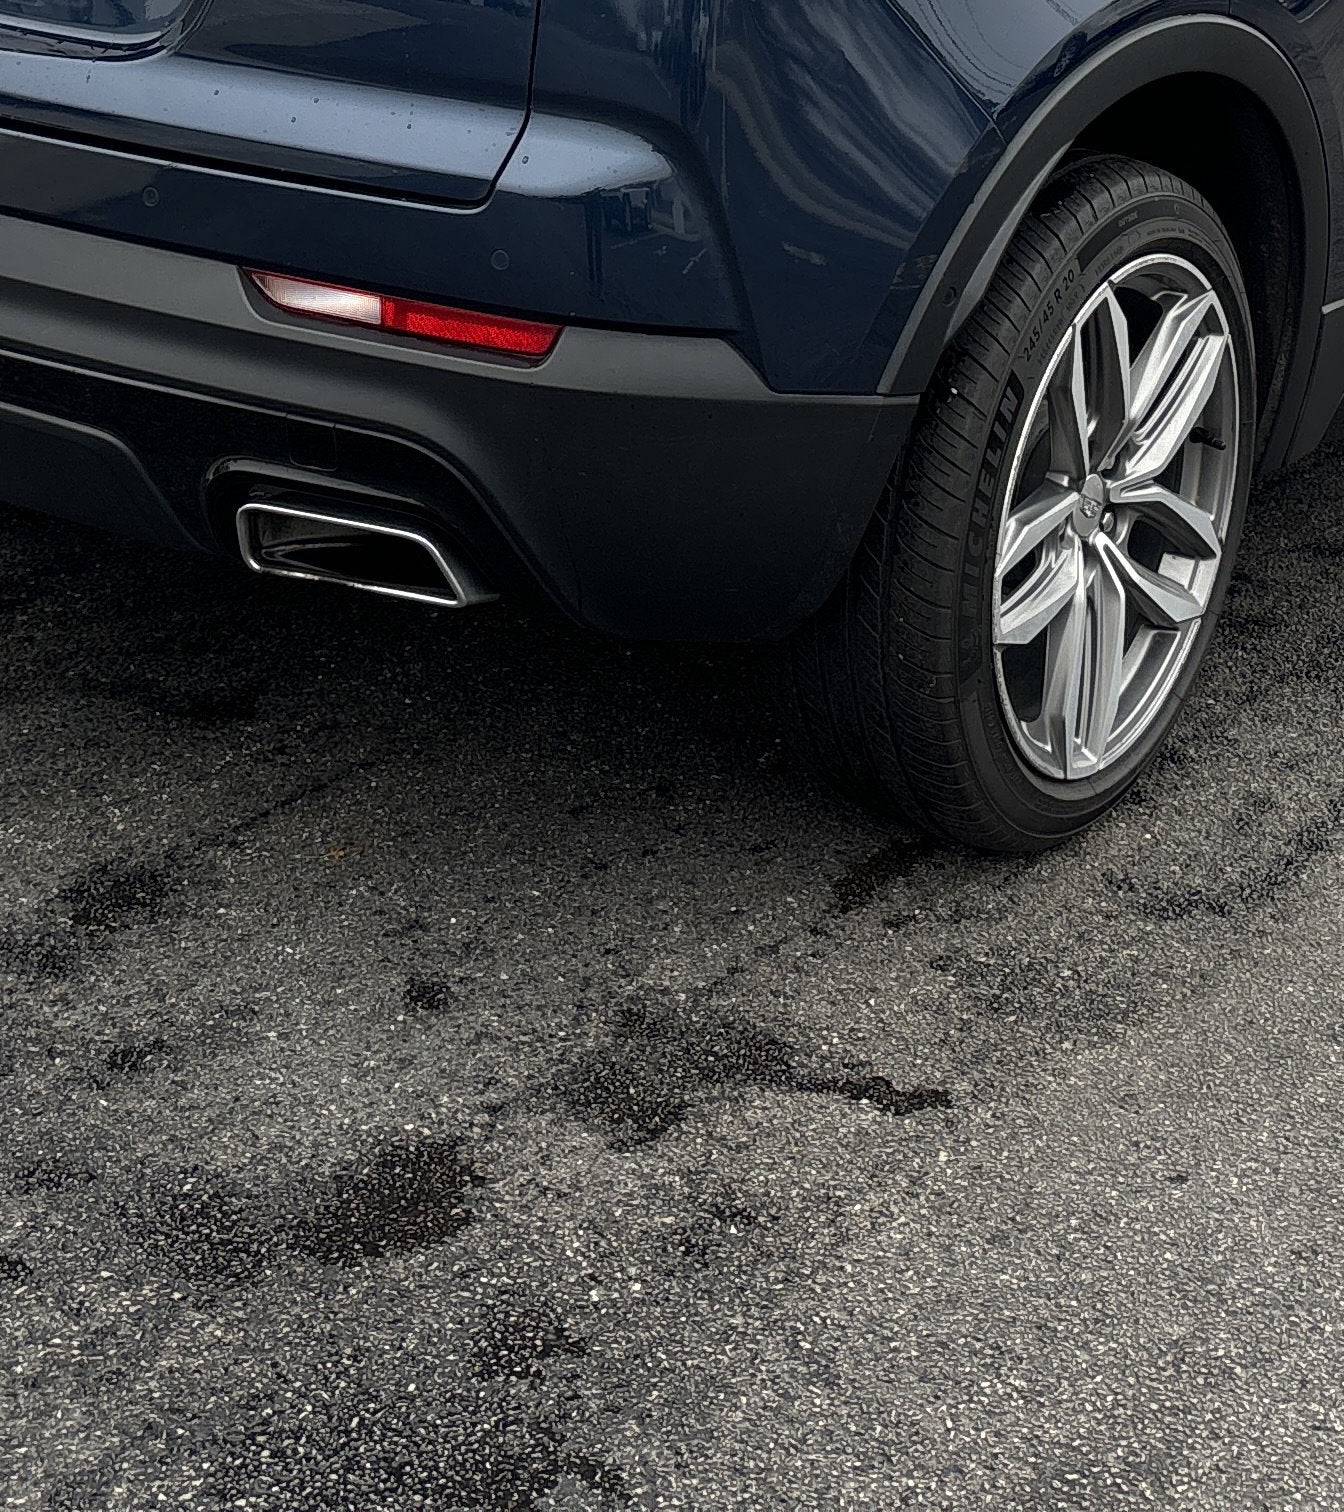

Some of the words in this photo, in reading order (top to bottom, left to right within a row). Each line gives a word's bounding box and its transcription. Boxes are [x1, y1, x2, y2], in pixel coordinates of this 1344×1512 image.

[1023, 300, 1055, 362] 245/45
[1053, 287, 1063, 304] R
[1062, 269, 1075, 292] 20
[961, 384, 1020, 618] MICHELIN
